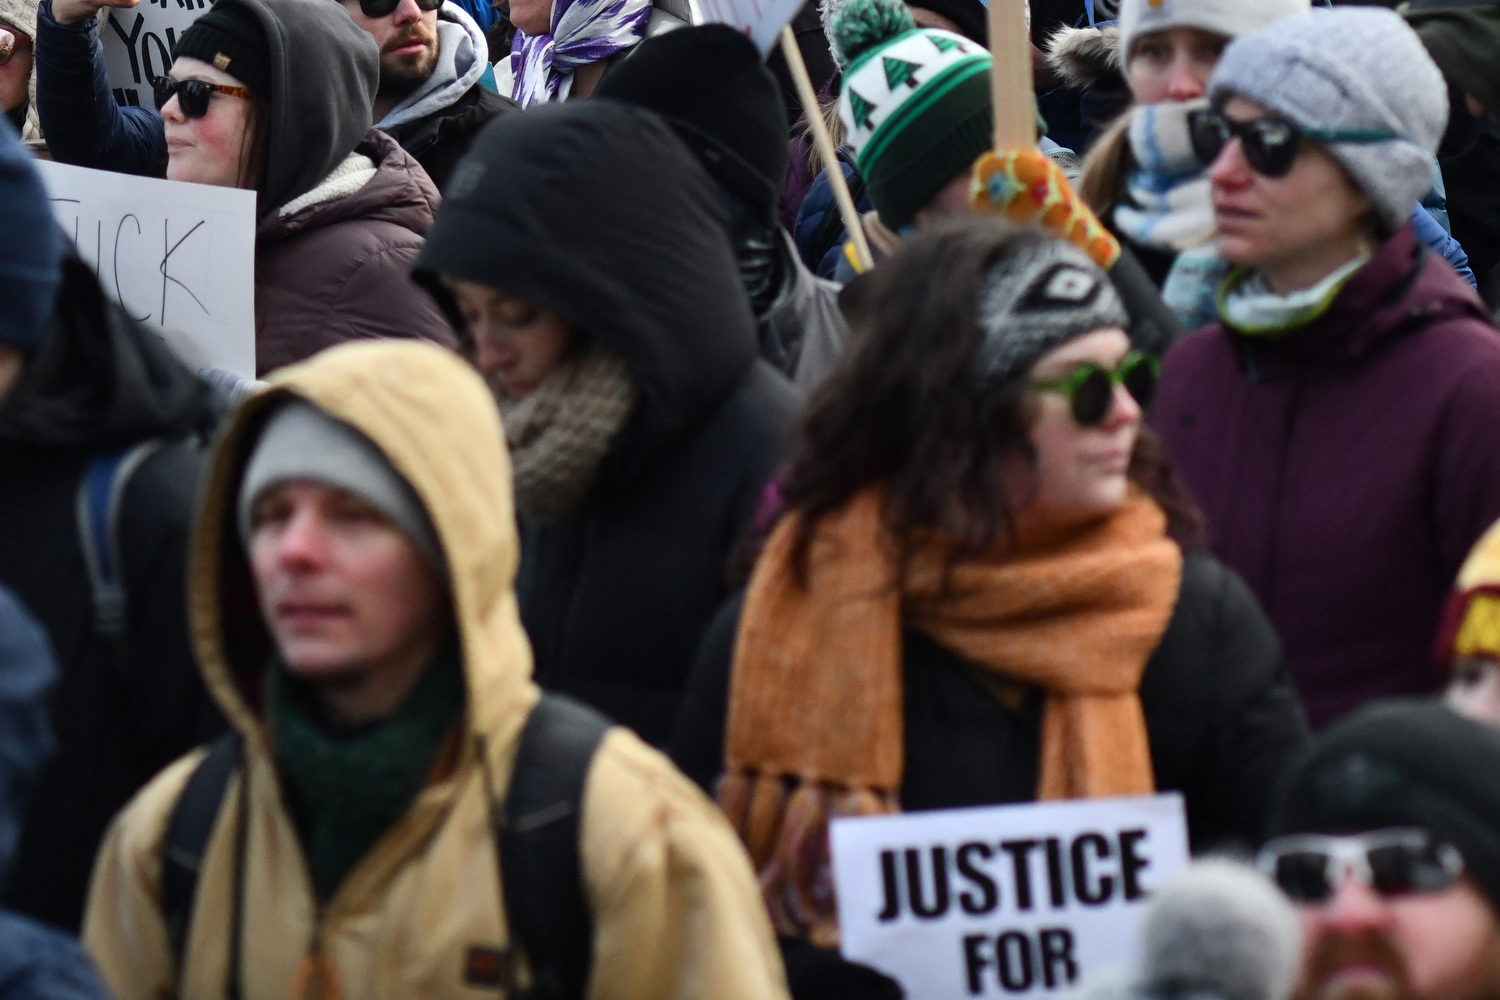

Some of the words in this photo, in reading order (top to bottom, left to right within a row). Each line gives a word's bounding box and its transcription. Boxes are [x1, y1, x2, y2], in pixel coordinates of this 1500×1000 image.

[50, 199, 211, 327] UCK
[878, 828, 1152, 923] JUSTICE
[962, 926, 1080, 996] FOR
